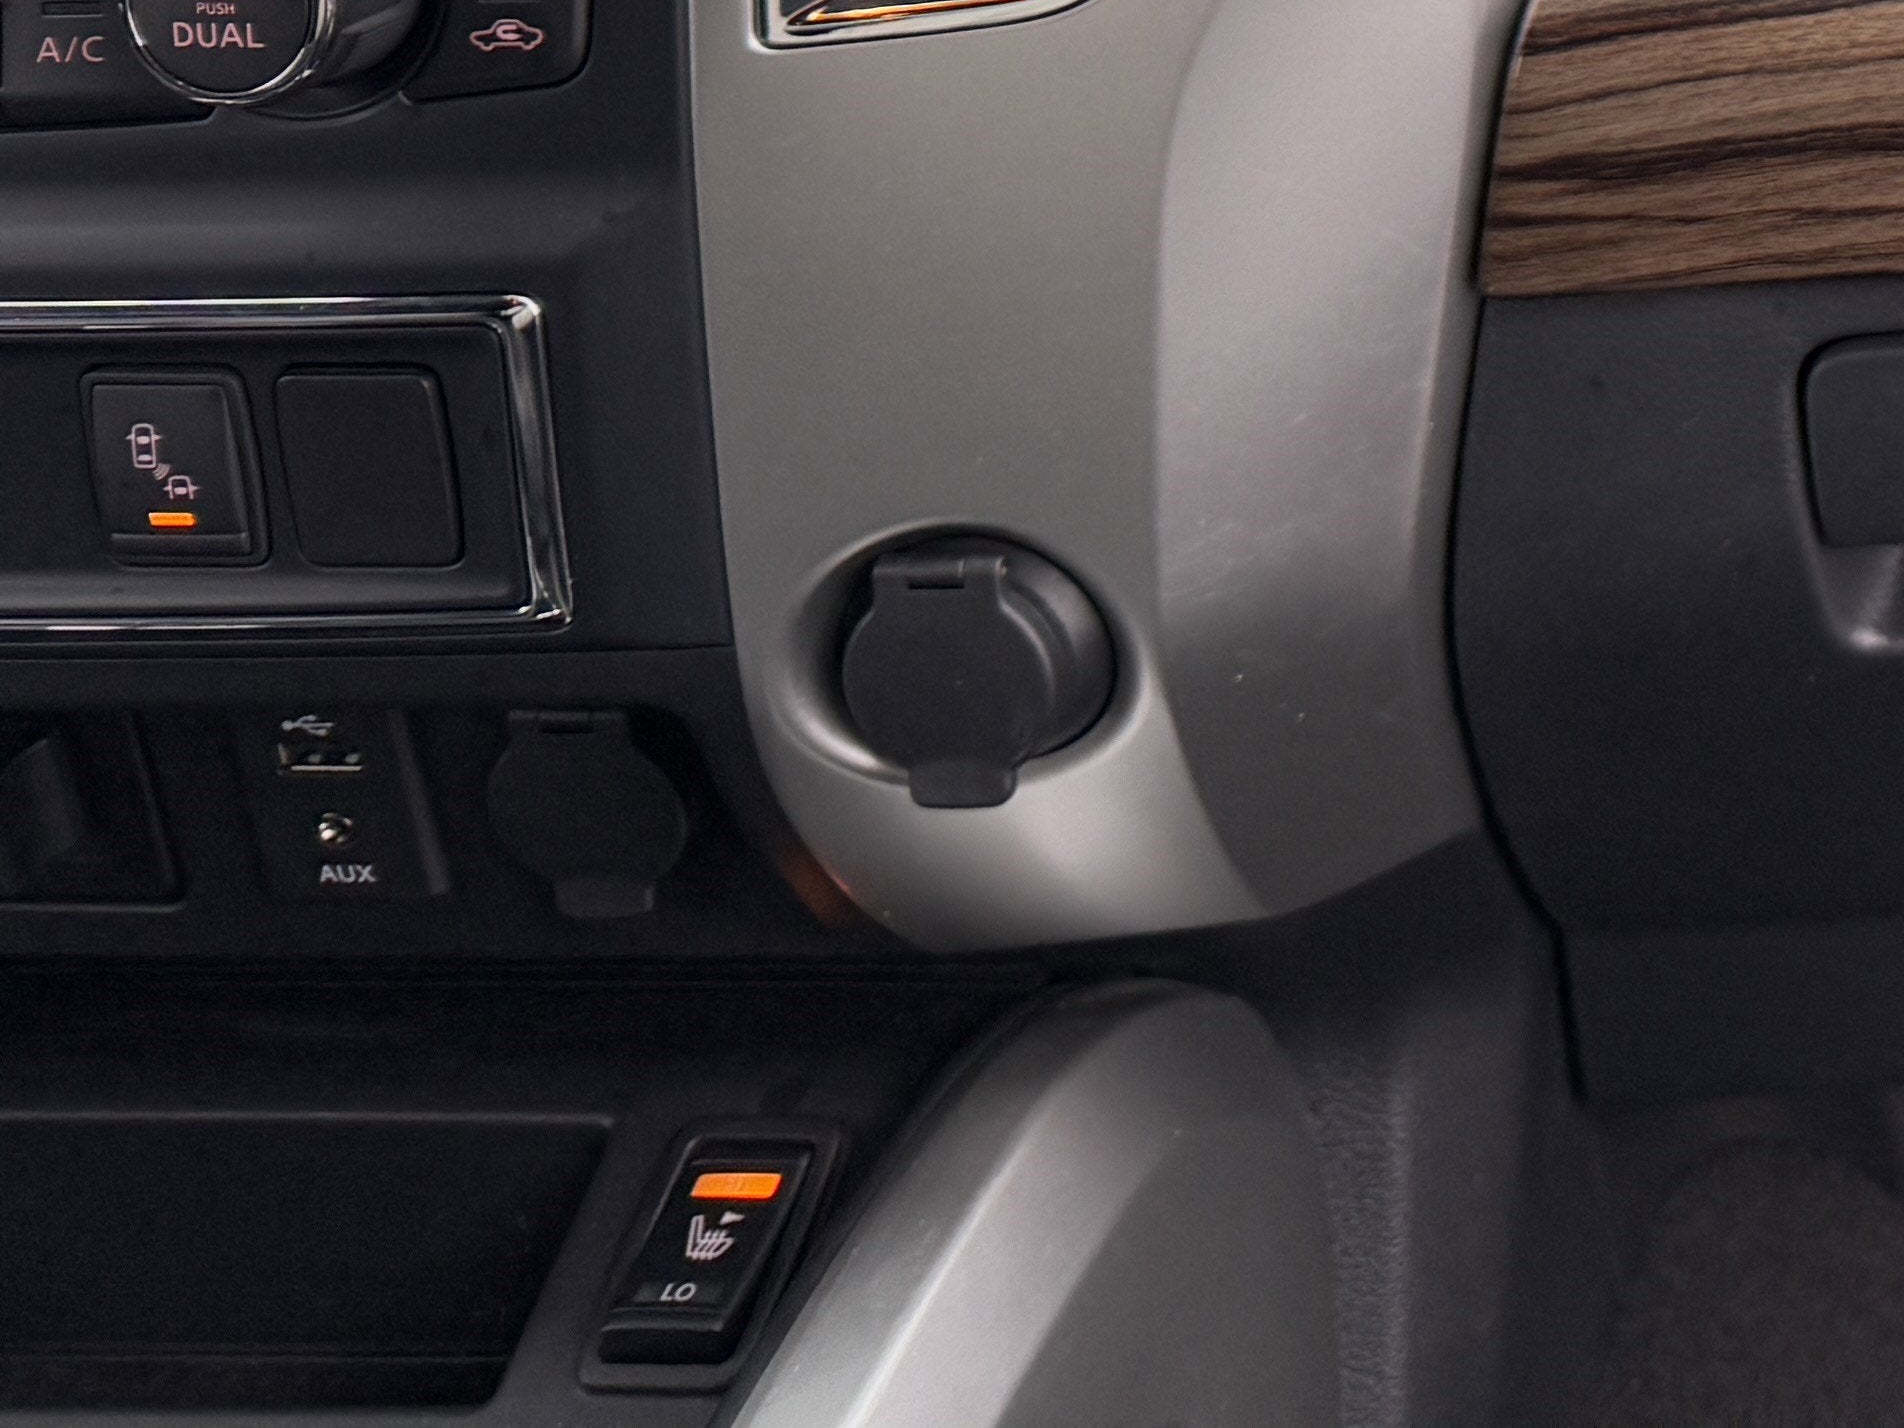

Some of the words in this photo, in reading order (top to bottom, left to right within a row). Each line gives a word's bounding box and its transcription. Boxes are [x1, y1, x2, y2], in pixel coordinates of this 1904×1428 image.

[196, 2, 236, 15] PUSH
[172, 21, 266, 49] DUAL
[36, 36, 105, 64] A/C
[320, 864, 377, 883] AUX
[659, 1282, 697, 1302] LO
